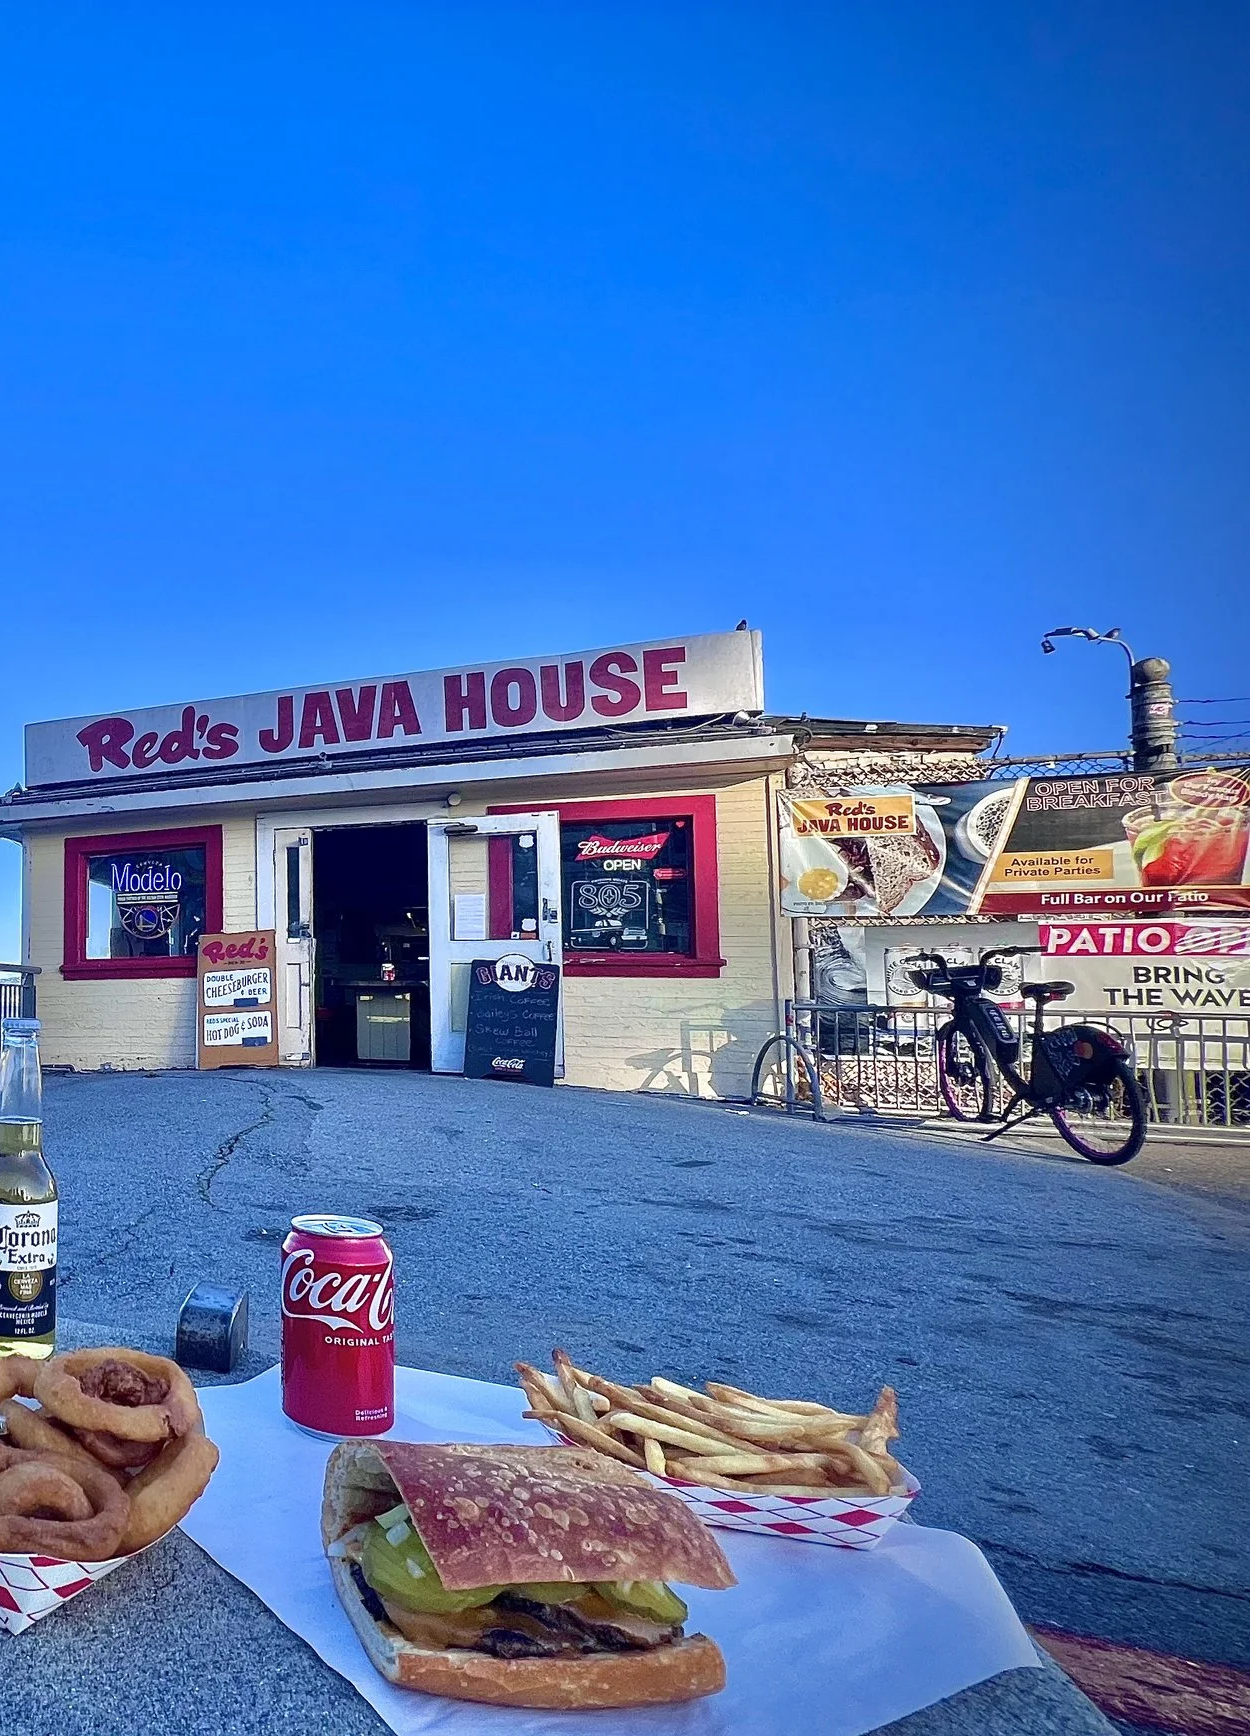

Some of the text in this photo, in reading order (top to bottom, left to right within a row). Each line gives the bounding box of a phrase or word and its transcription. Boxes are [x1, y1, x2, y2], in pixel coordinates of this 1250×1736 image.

[76, 646, 688, 773] Red's JAVA HOUSE
[1034, 776, 1155, 797] OPEN FOR
[825, 801, 876, 817] Red's
[1026, 789, 1168, 812] BREAKFAST
[797, 815, 909, 834] JAVA HOUSE
[577, 840, 662, 856] Budweiser
[603, 859, 642, 871] OPEN
[1011, 856, 1095, 867] Available for
[110, 863, 182, 891] Modelo
[1004, 866, 1101, 877] Private Parties
[578, 884, 642, 909] 805
[1041, 893, 1070, 905] Full
[1073, 893, 1102, 904] Bar
[1104, 895, 1127, 904] on
[1130, 892, 1164, 903] Our
[1049, 925, 1171, 954] PATIO
[201, 937, 269, 964] Red's
[206, 974, 234, 983] DOUBLE
[206, 972, 269, 998] CHEESEBURGER
[476, 964, 556, 990] GIANTS
[1133, 966, 1226, 985] BRING
[248, 988, 268, 996] BEER
[1103, 988, 1164, 1006] THE
[206, 1028, 223, 1041] HOT
[224, 1023, 240, 1039] DOG
[247, 1015, 269, 1030] SODA
[7, 1248, 46, 1264] Extra
[324, 1331, 395, 1347] ORIGINAL TAS
